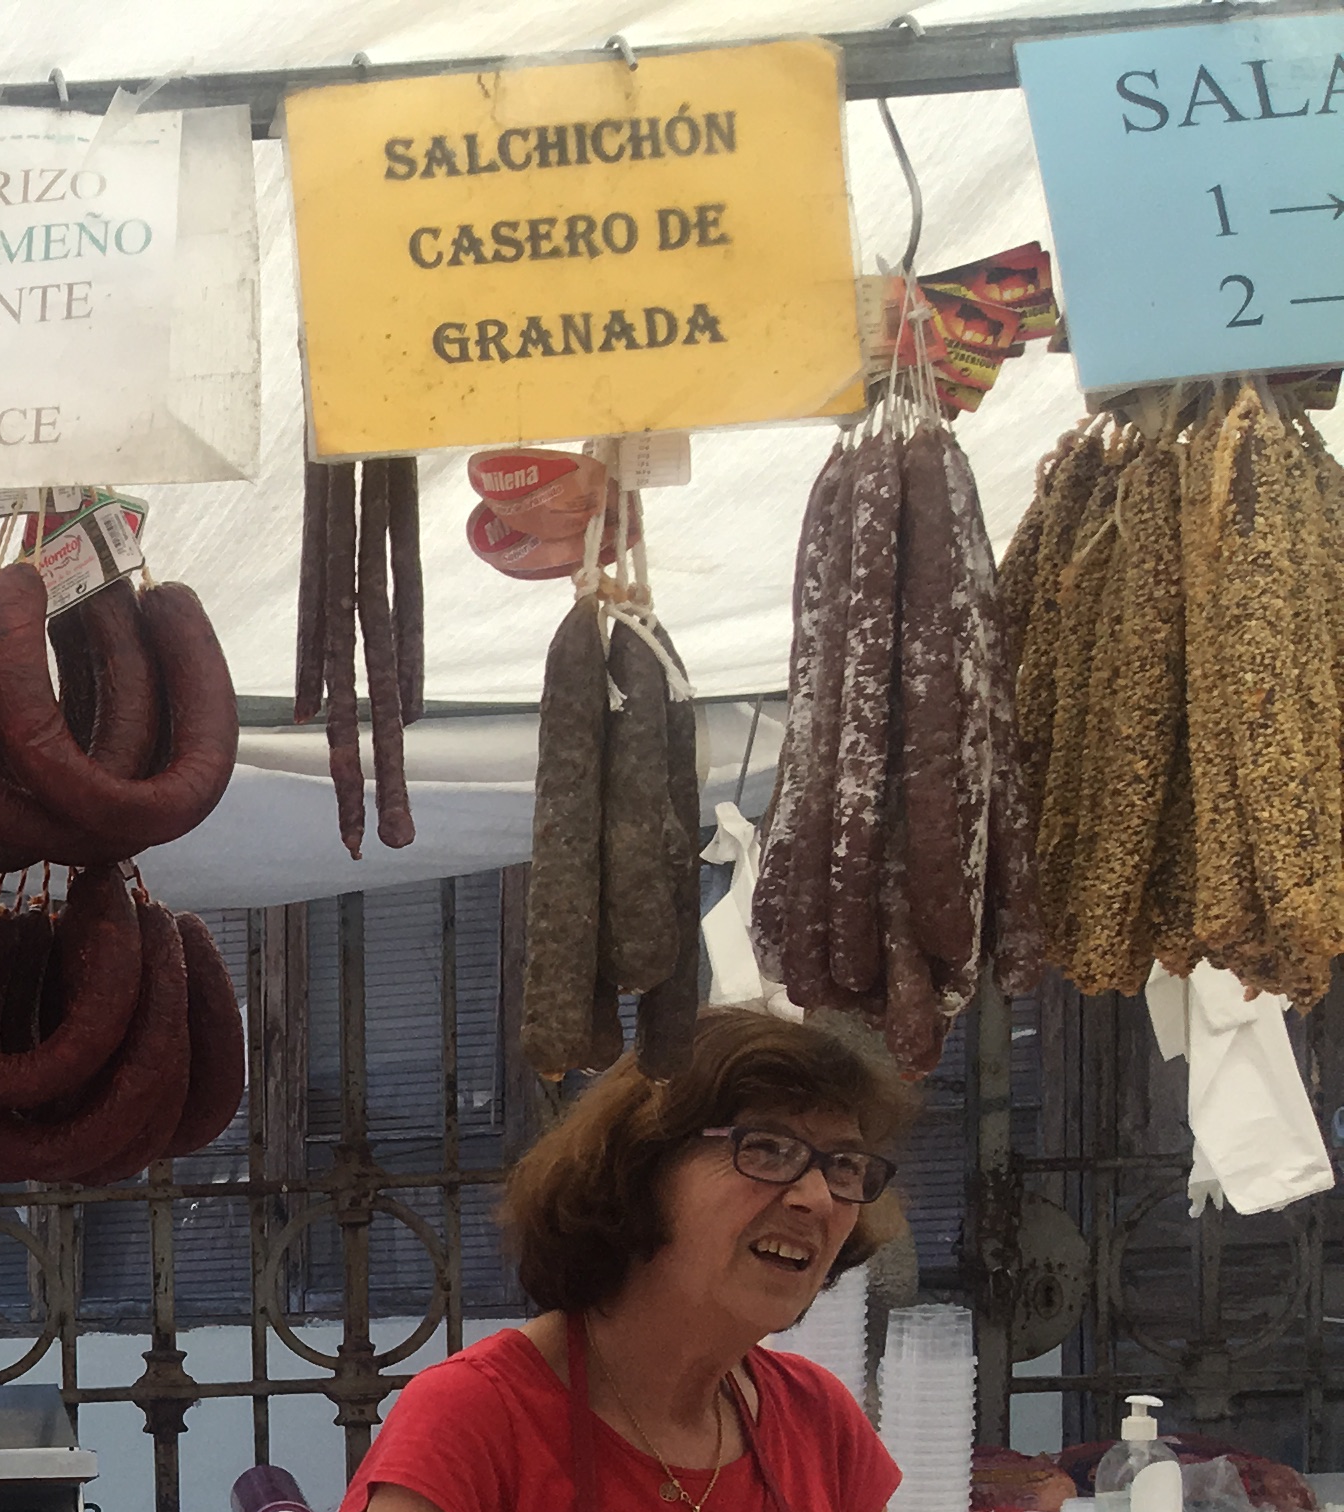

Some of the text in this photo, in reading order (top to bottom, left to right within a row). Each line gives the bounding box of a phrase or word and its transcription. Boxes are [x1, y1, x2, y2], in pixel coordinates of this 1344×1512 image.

[384, 103, 737, 181] SALCHICHÓN
[409, 203, 730, 269] CASERO DE
[1206, 184, 1238, 237] 1
[1220, 274, 1263, 328] 2
[433, 303, 728, 364] GRANADA
[481, 465, 539, 492] Milena
